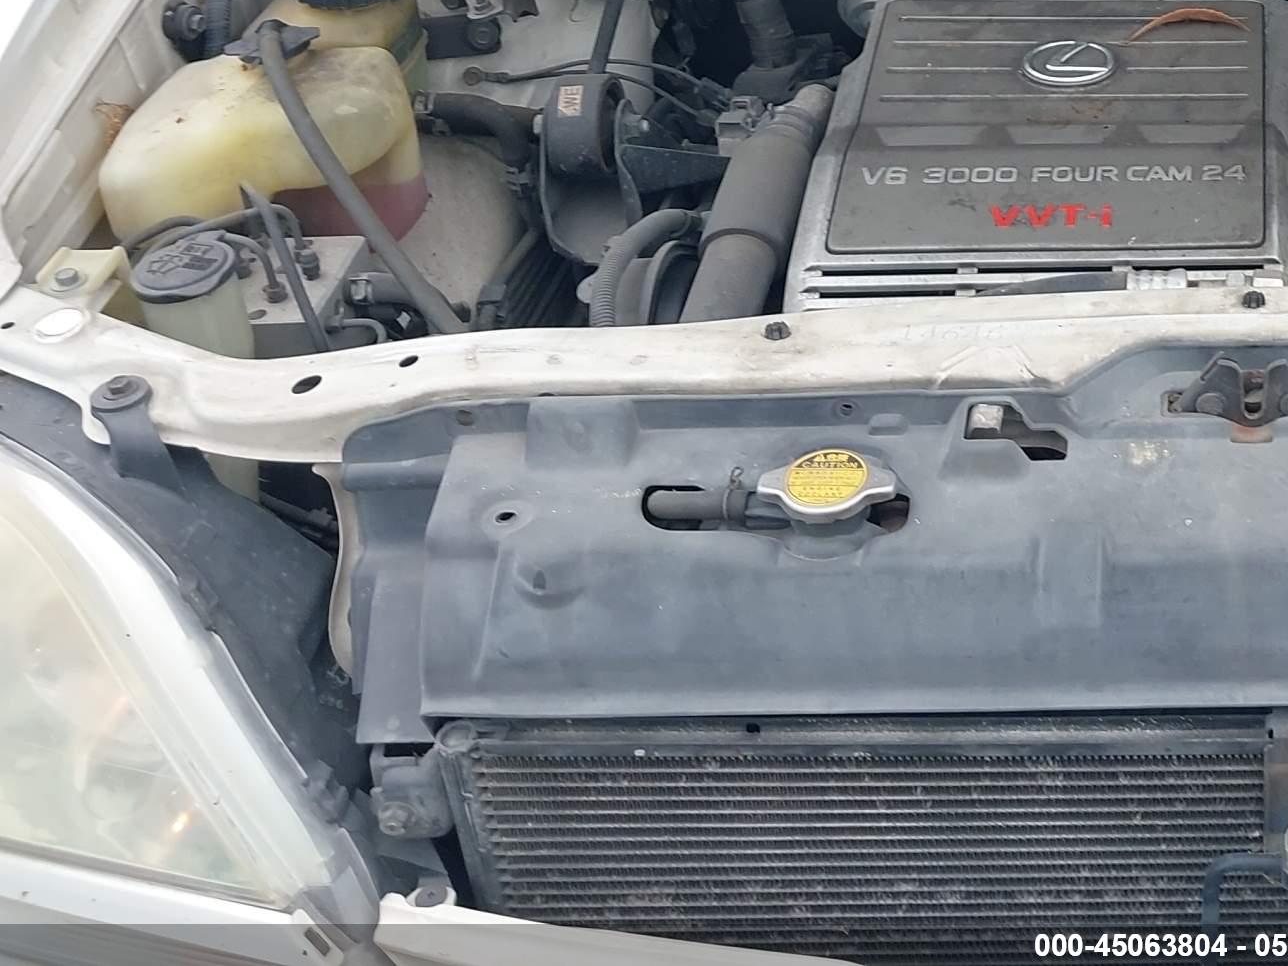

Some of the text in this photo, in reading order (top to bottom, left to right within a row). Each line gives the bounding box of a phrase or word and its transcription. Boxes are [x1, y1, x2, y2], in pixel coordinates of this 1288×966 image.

[861, 164, 1247, 185] V6 3000 FOUR CAM 24
[990, 203, 1113, 228] VVT-i
[802, 460, 859, 469] CAUTION
